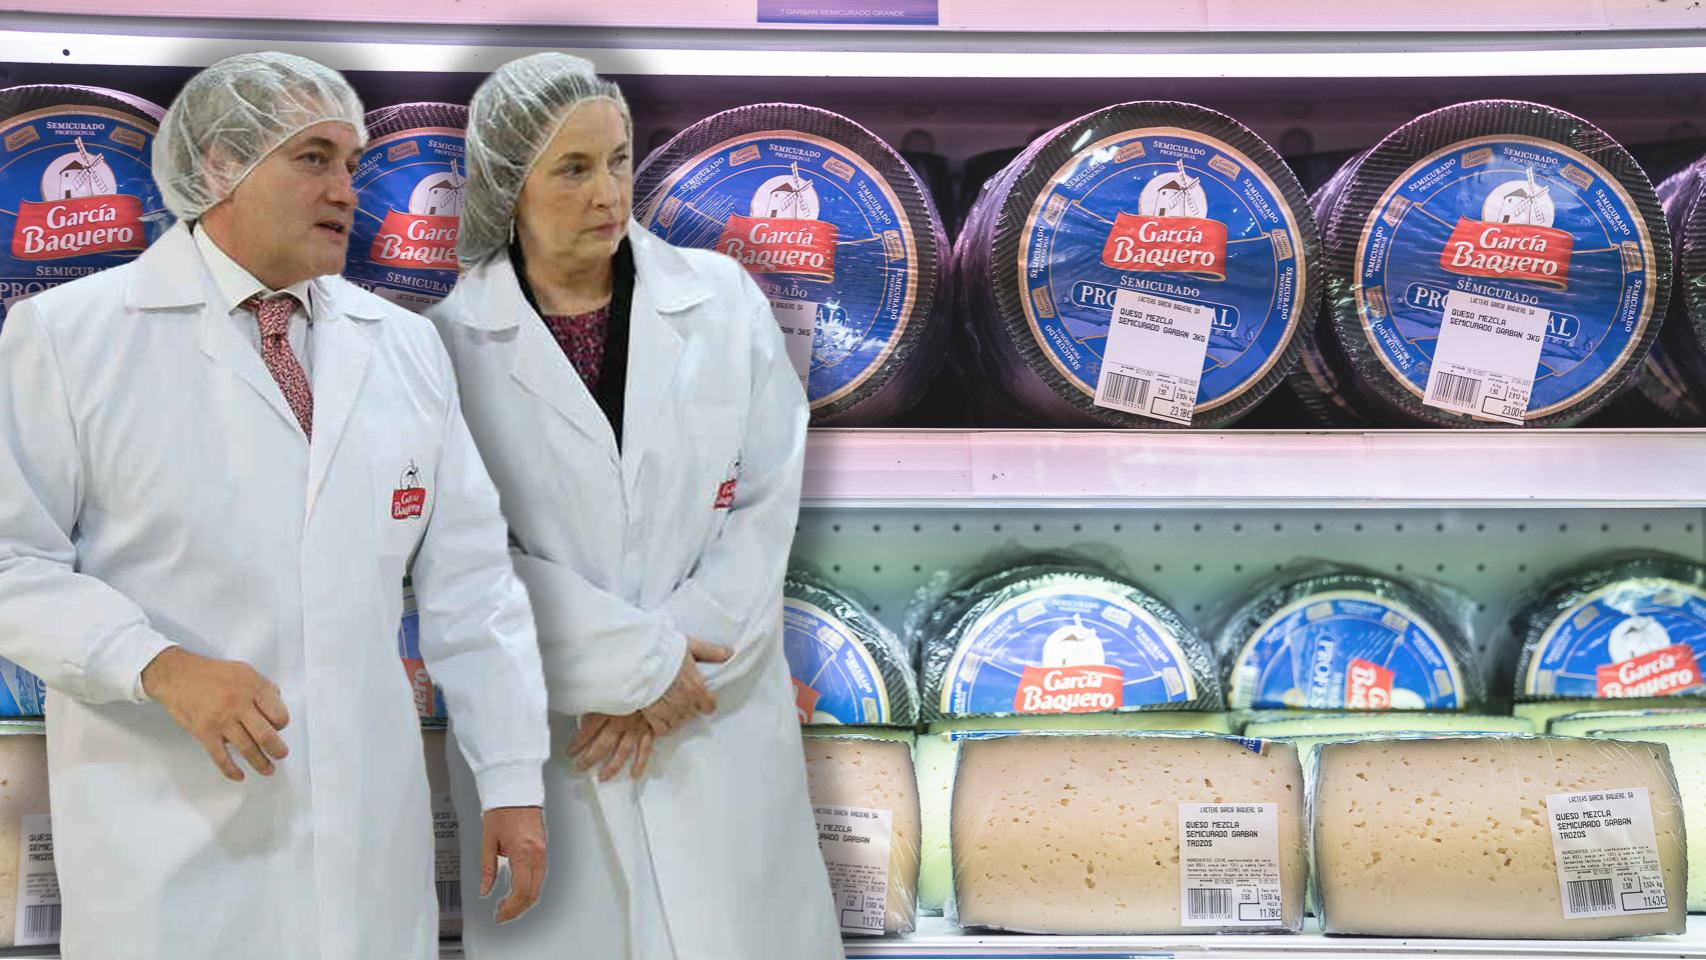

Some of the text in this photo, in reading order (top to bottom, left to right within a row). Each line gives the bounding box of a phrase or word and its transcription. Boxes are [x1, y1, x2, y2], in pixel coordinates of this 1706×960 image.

[821, 9, 872, 17] SEMICURADO
[46, 121, 105, 131] SEMICURADO
[768, 143, 821, 158] SEMICURADO
[1152, 141, 1206, 156] SEMICURADO
[1159, 149, 1197, 161] PROFESIONAL
[1503, 147, 1559, 166] SEMICURADO
[679, 156, 725, 191] SEMICURADO
[1407, 158, 1456, 192] SEMICURADO
[856, 180, 892, 225] SEMICURADO
[1242, 179, 1279, 224] SEMICURADO
[1595, 188, 1631, 236] SEMICURADO
[47, 204, 117, 230] García
[22, 223, 134, 255] Baquero
[407, 219, 456, 241] Garc
[749, 222, 814, 247] García
[1139, 221, 1204, 245] García
[1480, 227, 1547, 252] García
[381, 233, 458, 264] Baque
[724, 237, 824, 272] Baquero
[1030, 225, 1044, 279] SEMICURADO
[1112, 237, 1215, 267] Baquero
[1365, 226, 1385, 278] SEMICURADO
[1451, 241, 1558, 275] Baquero
[1120, 275, 1200, 298] SEMICURADO
[1281, 267, 1295, 320] SEMICURADO
[1456, 278, 1539, 305] SEMICURADO
[1120, 308, 1173, 326] QUESO MEZCLA
[1452, 308, 1506, 326] QUESO MEZCLA
[1624, 278, 1643, 333] SEMICURADO
[1118, 317, 1160, 332] SEMICURADO
[1163, 327, 1190, 339] GARBAN
[1192, 333, 1206, 342] 3KG
[1449, 317, 1541, 343] SEMICURADO GARBAN 3KG
[1045, 324, 1081, 370] SEMICURADO
[1043, 670, 1103, 692] García
[1023, 686, 1115, 712] Baquero
[1186, 821, 1239, 829] QUESO MEZCLA
[1555, 809, 1612, 821] QUESO MEZCLA
[1558, 817, 1632, 830] SEMICURADO GARBAN
[823, 824, 853, 833] MEZCLA
[1186, 830, 1258, 838] SEMICURADO GARBAN
[1560, 830, 1587, 840] TROZOS
[1186, 839, 1213, 848] TROZOS
